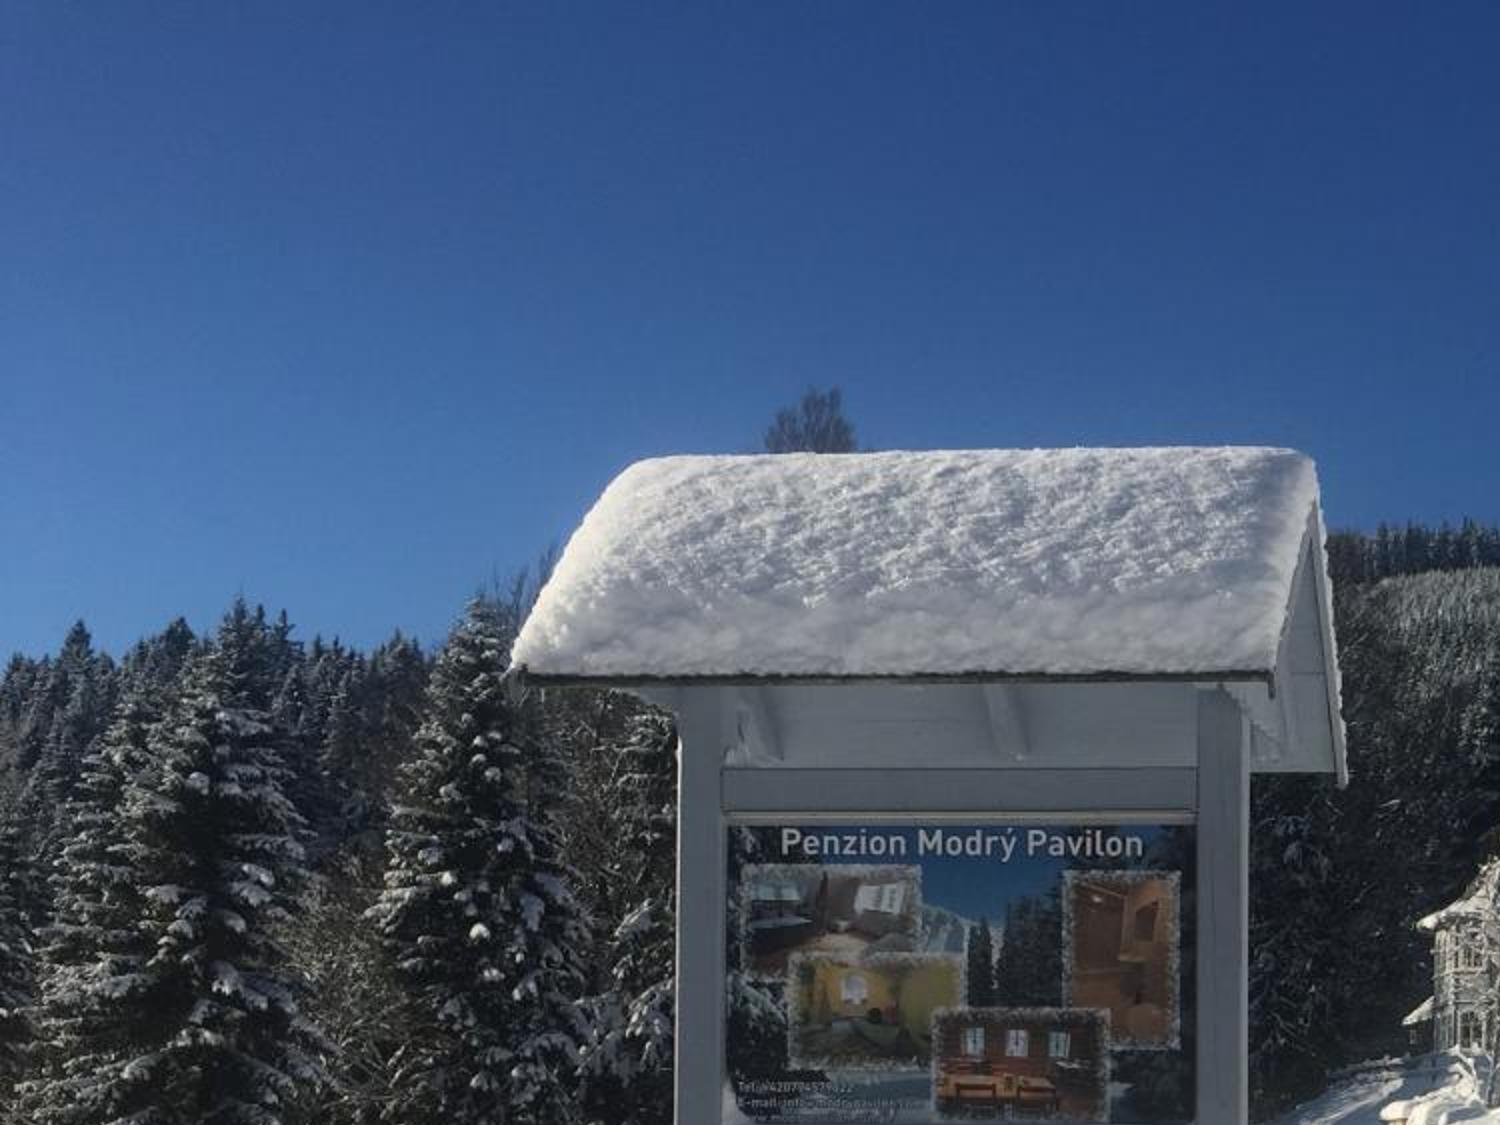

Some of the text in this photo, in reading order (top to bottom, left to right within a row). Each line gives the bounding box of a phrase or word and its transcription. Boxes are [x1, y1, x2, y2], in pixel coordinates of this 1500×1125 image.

[781, 828, 1143, 862] Penzion Modrý Pavilon
